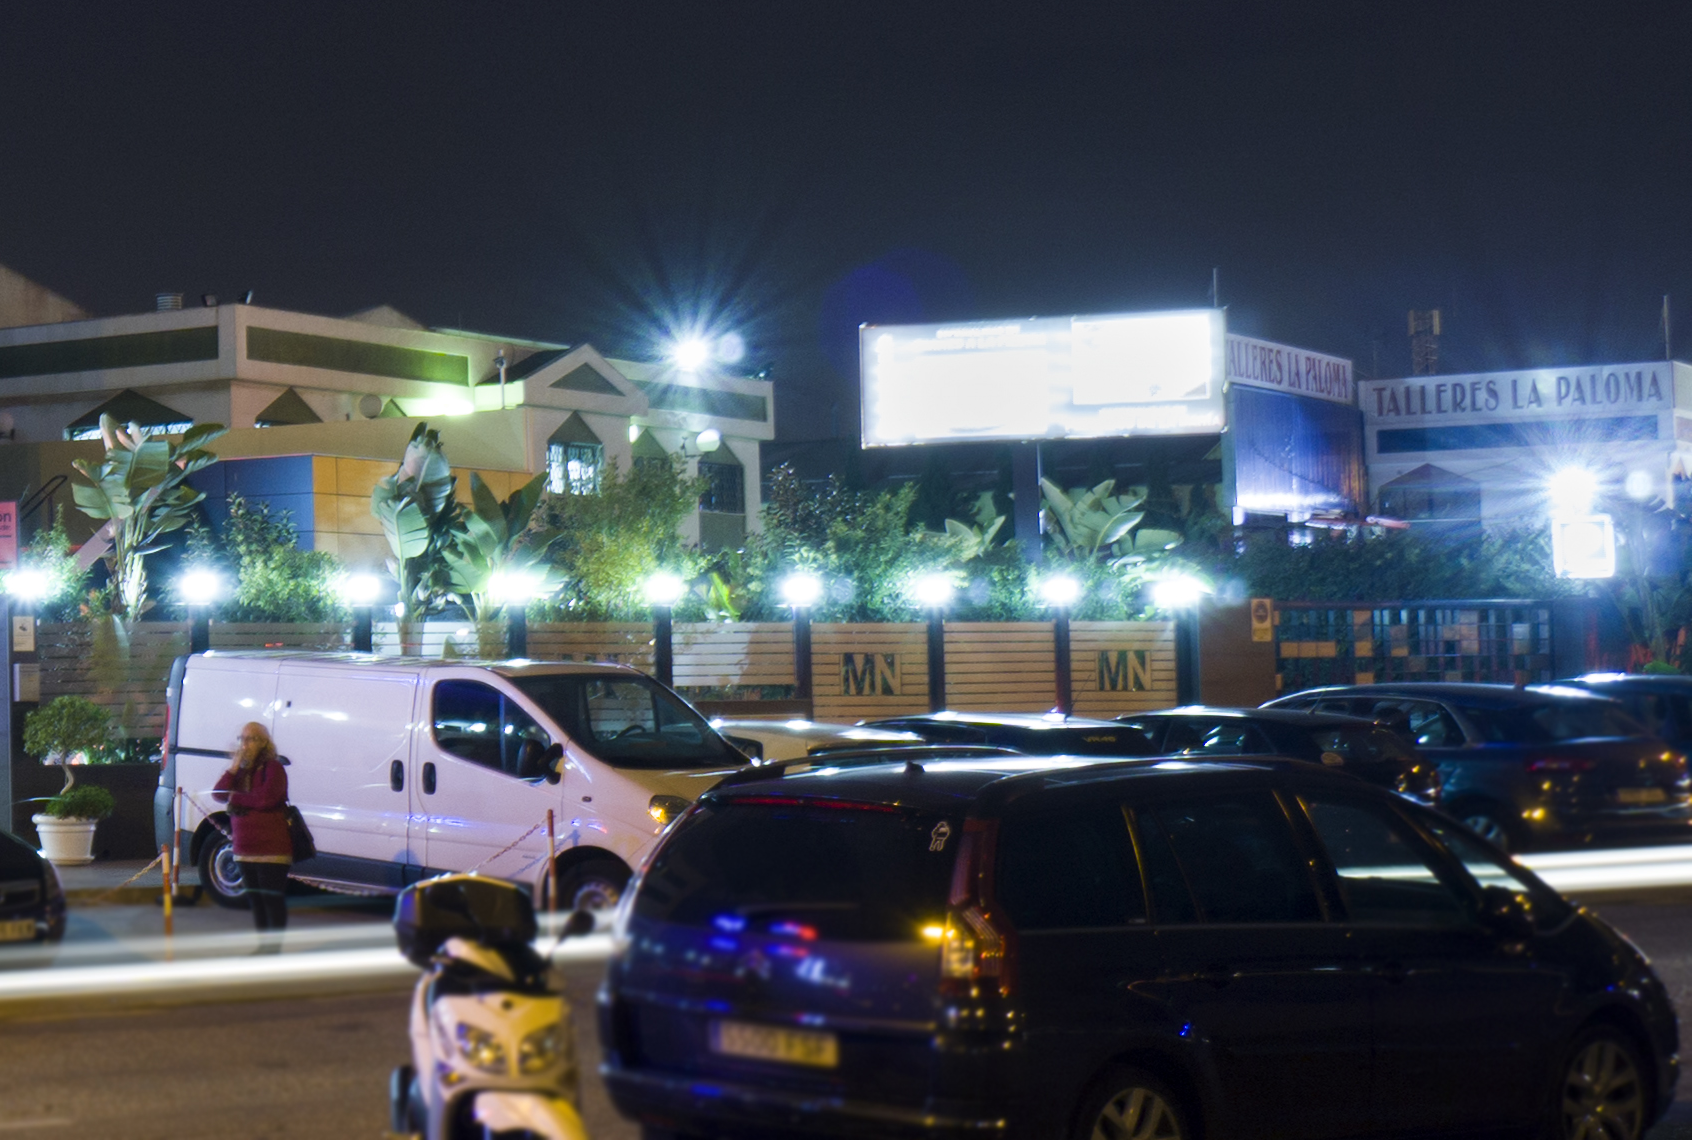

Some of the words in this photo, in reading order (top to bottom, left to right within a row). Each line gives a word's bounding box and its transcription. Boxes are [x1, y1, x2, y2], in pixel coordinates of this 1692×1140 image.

[1226, 340, 1283, 385] ALLERES
[1287, 352, 1301, 389] LA
[1305, 356, 1348, 399] PALOMA
[1373, 380, 1500, 418] TALLERES
[1511, 379, 1542, 409] LA
[1556, 370, 1664, 407] PALOMA
[843, 653, 902, 695] MN
[1100, 650, 1153, 690] MN
